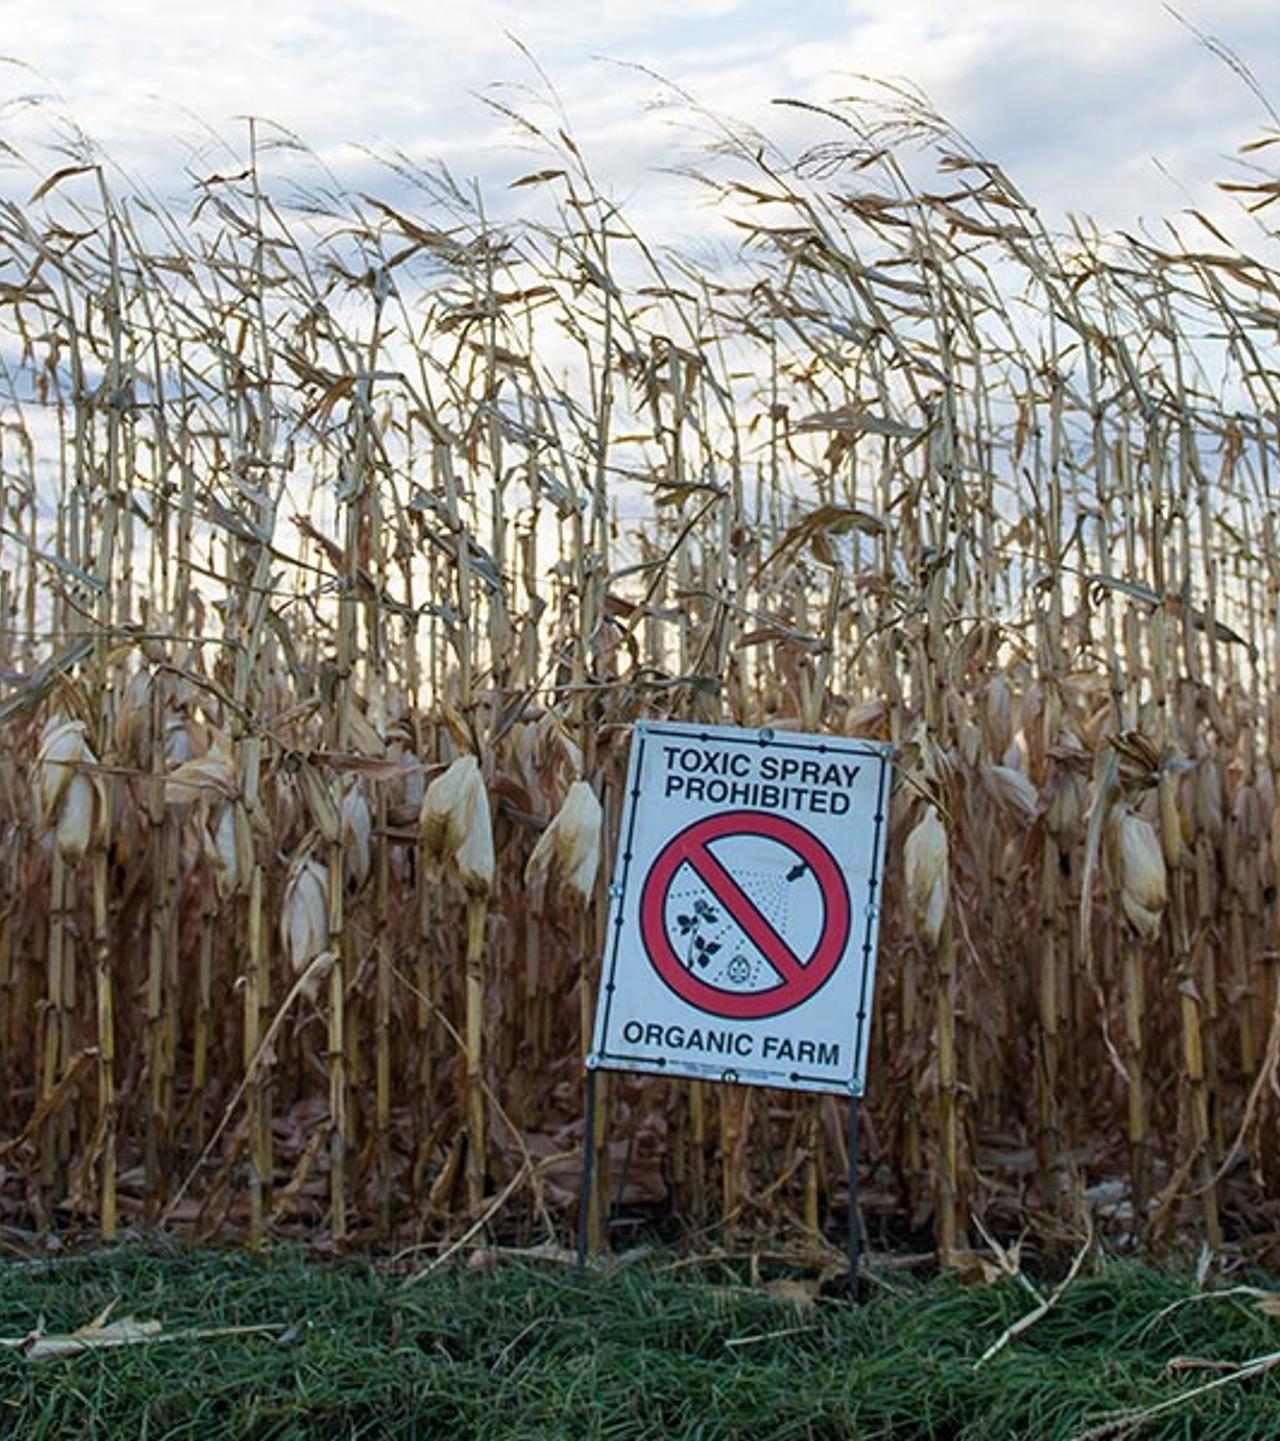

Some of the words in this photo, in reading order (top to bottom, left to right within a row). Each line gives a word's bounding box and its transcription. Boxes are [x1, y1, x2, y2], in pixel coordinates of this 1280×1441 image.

[663, 746, 751, 777] TOXIC
[758, 757, 861, 788] SPRAY
[664, 775, 851, 816] PROHIBITED
[623, 1021, 754, 1056] ORGANIC
[761, 1037, 840, 1066] FARM
